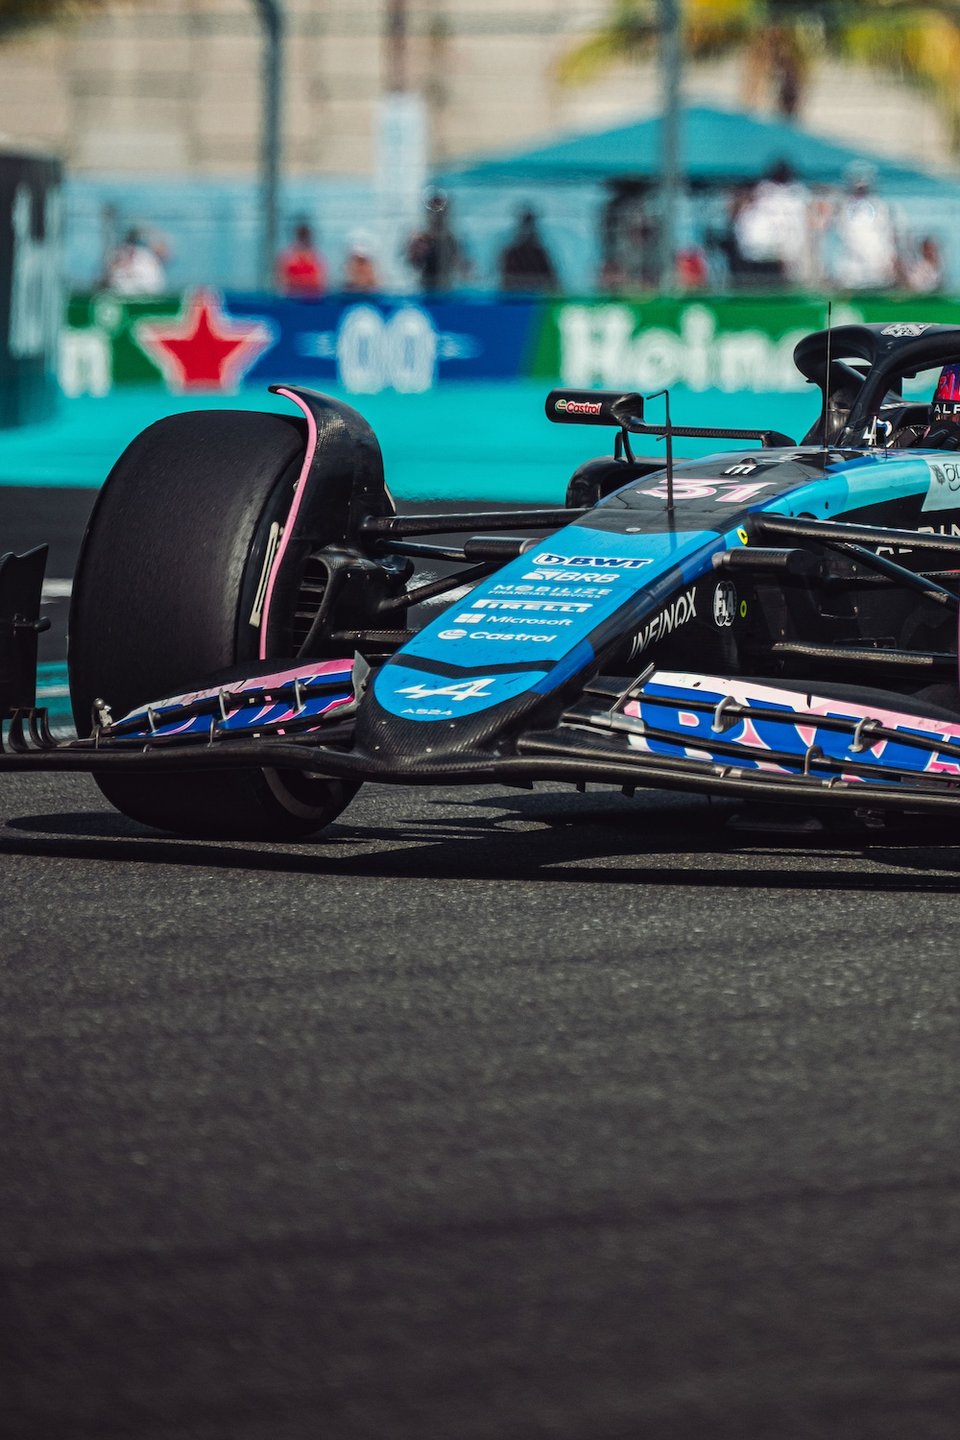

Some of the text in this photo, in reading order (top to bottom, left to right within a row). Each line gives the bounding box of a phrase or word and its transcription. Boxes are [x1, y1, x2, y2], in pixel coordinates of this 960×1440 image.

[566, 400, 602, 415] Castrol
[637, 478, 777, 503] 31
[563, 557, 653, 569] BWT
[553, 572, 620, 583] BRB
[491, 584, 613, 596] MOBILIZE
[470, 599, 594, 613] PIRELLI
[486, 615, 573, 627] Microsoft
[626, 586, 697, 664] INFINOX
[469, 631, 558, 643] Castrol
